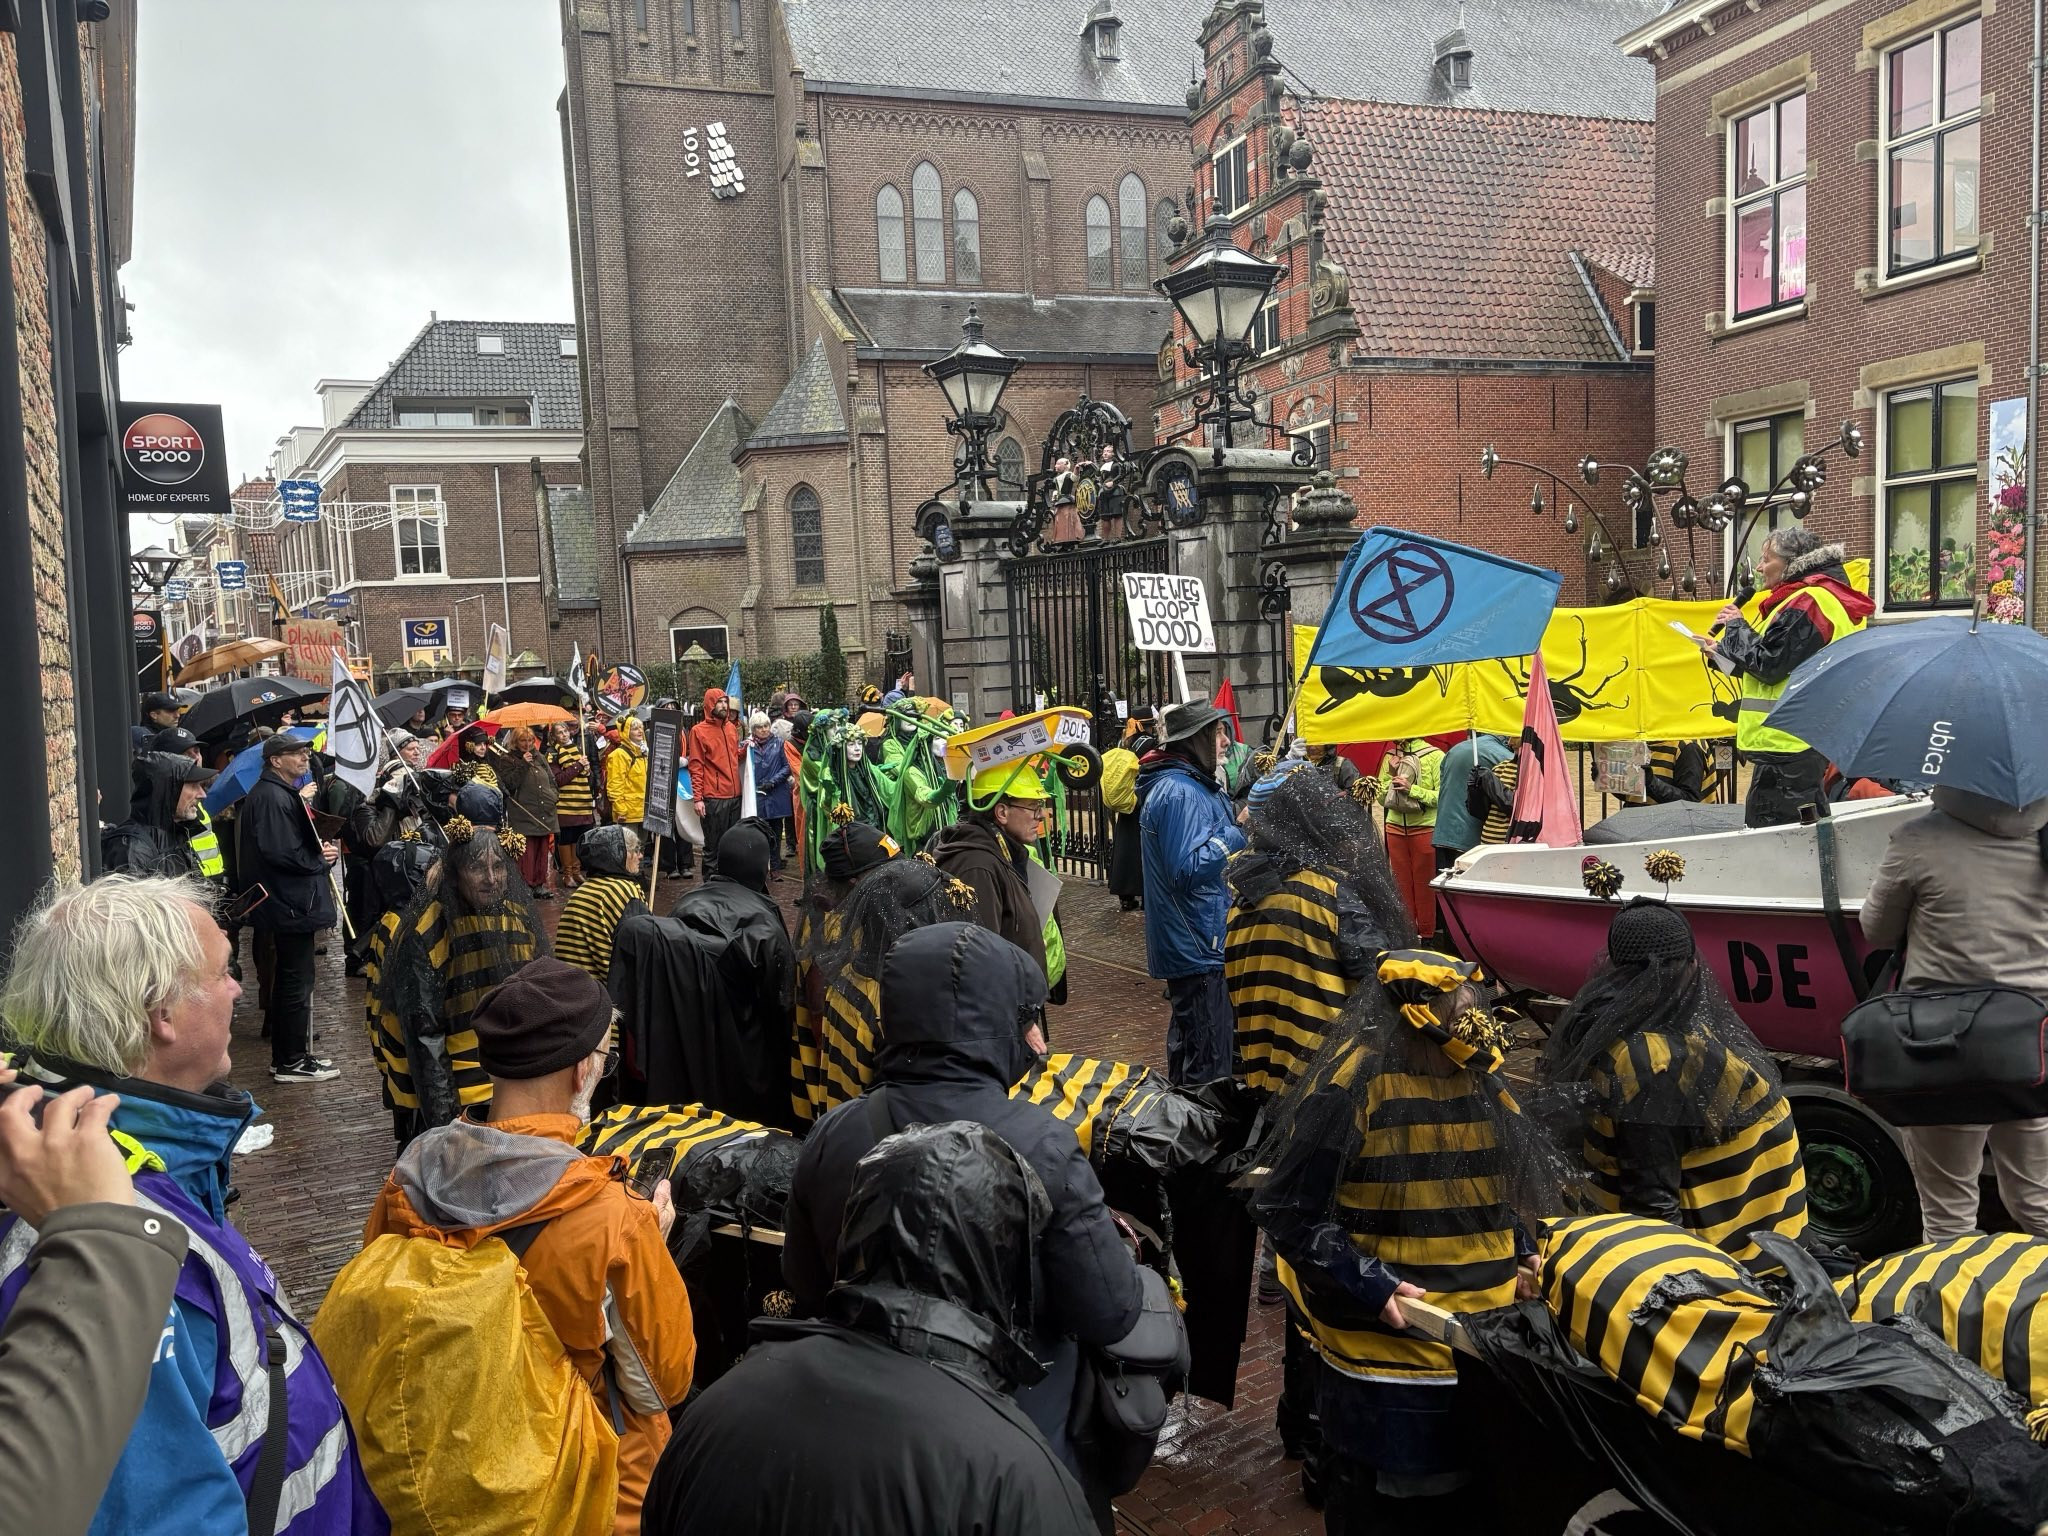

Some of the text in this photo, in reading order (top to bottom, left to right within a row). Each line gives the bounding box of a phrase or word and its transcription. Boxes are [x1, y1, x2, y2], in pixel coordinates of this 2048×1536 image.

[131, 435, 195, 449] SPORT
[138, 450, 191, 463] 2000
[128, 493, 210, 502] HOME OF EXPERTS
[1126, 575, 1200, 602] DEZE WEG
[1144, 599, 1199, 622] LOOPT
[414, 637, 440, 645] Primera
[1138, 617, 1202, 648] DOOD
[1061, 719, 1088, 739] DOLF
[1921, 721, 1956, 776] ubica
[1727, 941, 1817, 1010] DE
